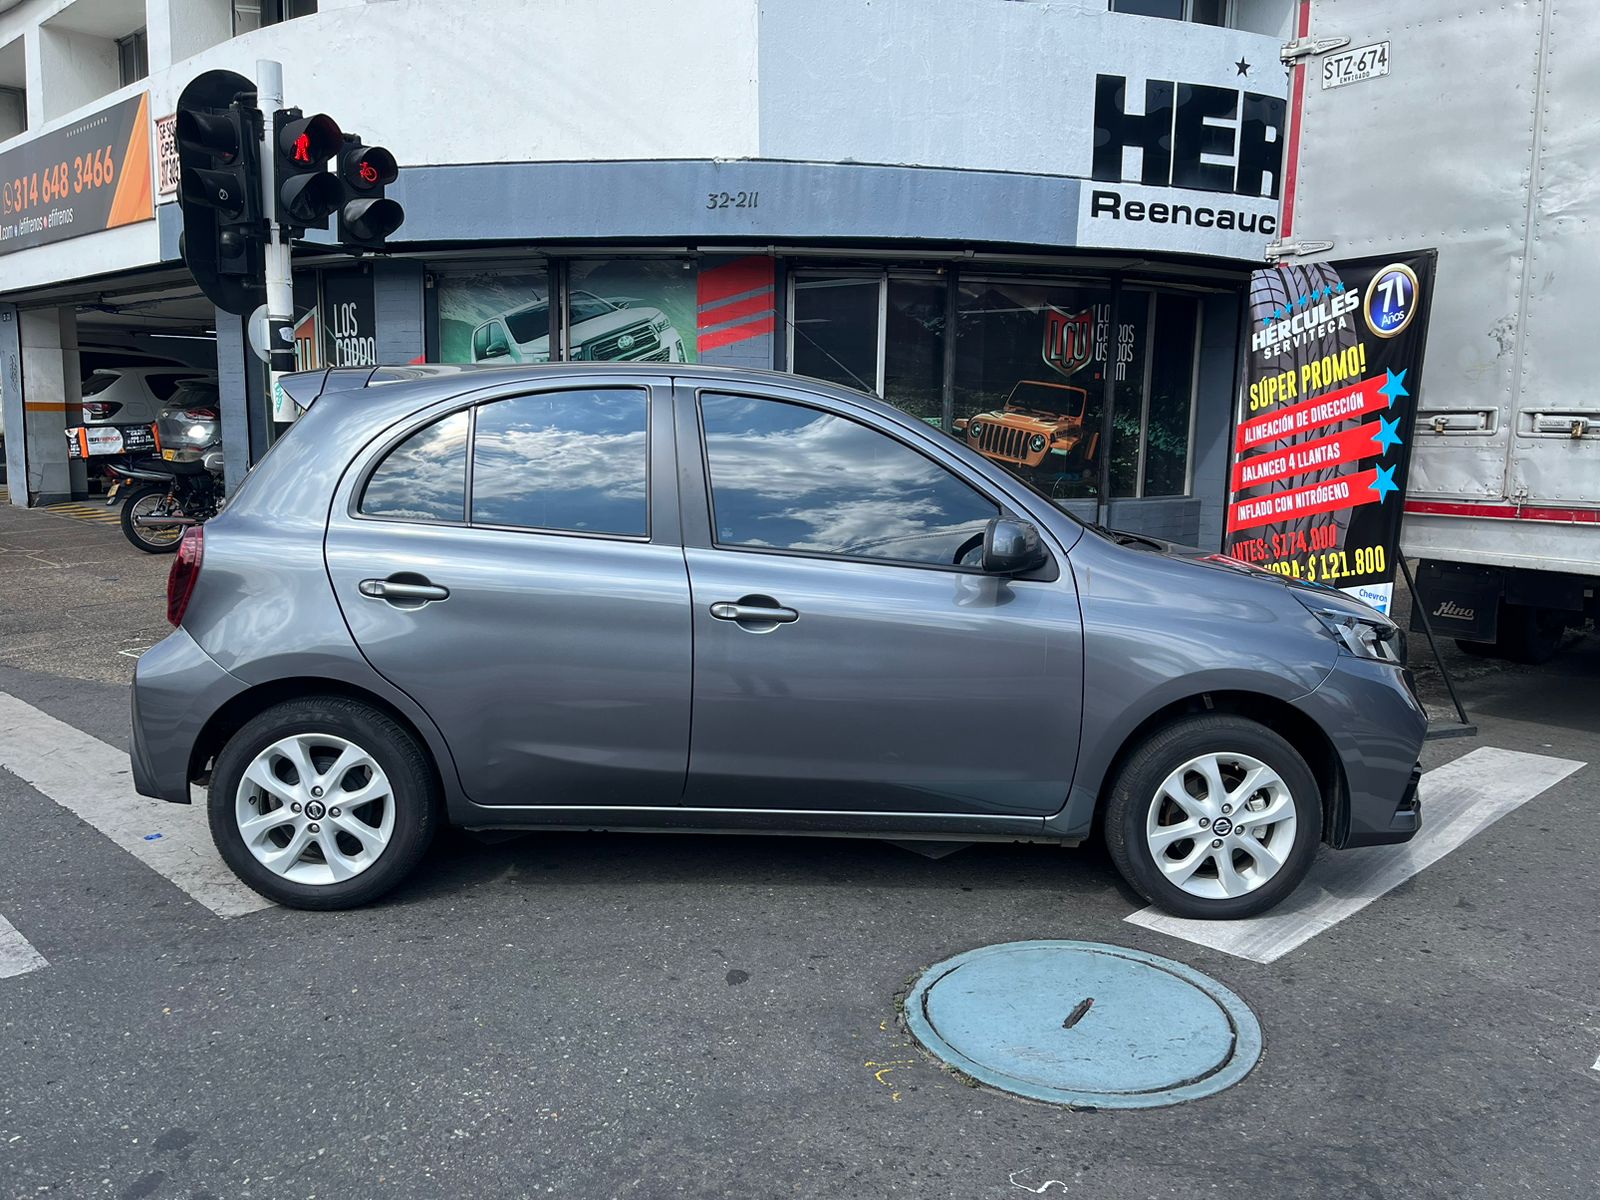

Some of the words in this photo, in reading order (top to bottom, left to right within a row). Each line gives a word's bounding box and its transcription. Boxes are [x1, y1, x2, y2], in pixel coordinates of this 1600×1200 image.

[1339, 71, 1370, 83] ENVIGADO
[14, 172, 39, 212] 314
[42, 162, 69, 203] 648
[73, 144, 114, 194] 3466
[706, 191, 759, 209] 32-211
[1091, 190, 1276, 234] Reencauc
[1377, 274, 1405, 313] 71
[333, 302, 358, 338] LOS
[1252, 288, 1360, 352] HÉRCULES
[1381, 310, 1405, 327] Años
[1263, 317, 1347, 360] SERVITECA
[1250, 371, 1297, 411] SÚPER
[1301, 343, 1367, 394] PROMO!
[1244, 414, 1294, 445] ALINEACIÓN
[1296, 410, 1309, 428] DE
[1310, 391, 1365, 423] DIRECCIÓN
[1242, 457, 1287, 483] BALANCEO
[1289, 453, 1296, 470] 4
[1297, 442, 1341, 468] LLANTAS
[1237, 499, 1273, 521] INFLADO
[1275, 495, 1294, 513] CON
[1295, 482, 1349, 509] NITRÓGENO
[1231, 538, 1270, 562] ANTES:
[1272, 524, 1338, 559] $174.000
[1308, 554, 1318, 582] $
[1320, 545, 1386, 580] 121.800
[1359, 588, 1388, 603] Chevron
[1432, 601, 1474, 620] Hino
